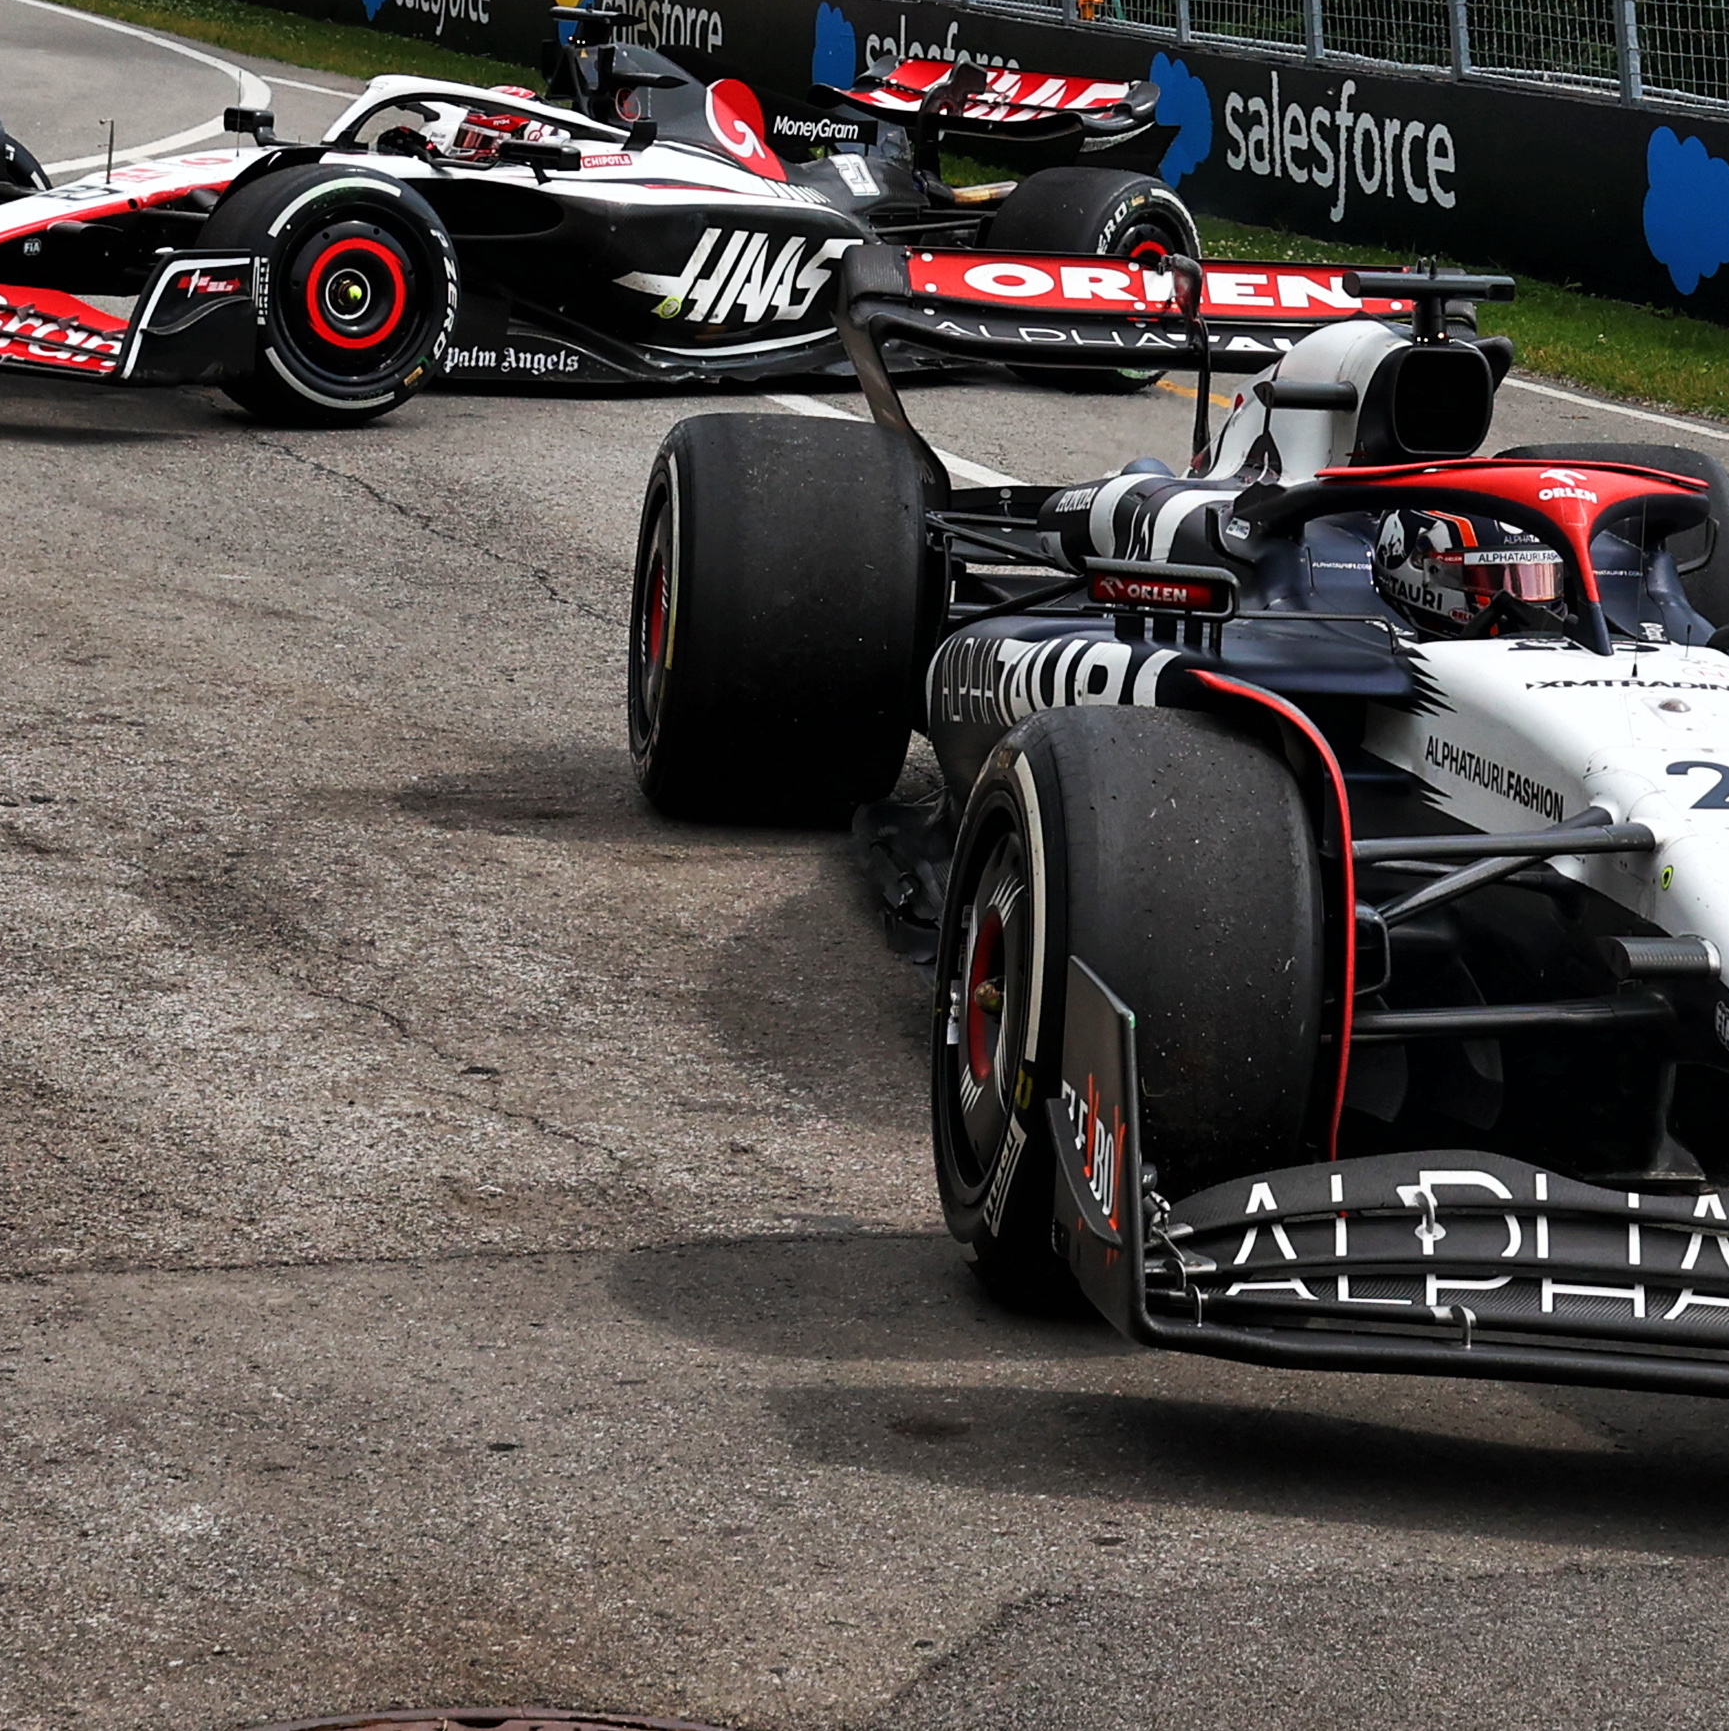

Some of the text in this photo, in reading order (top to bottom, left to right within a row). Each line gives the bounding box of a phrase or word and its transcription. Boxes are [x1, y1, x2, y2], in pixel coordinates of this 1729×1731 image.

[774, 115, 859, 141] MoneyGram
[1225, 70, 1457, 223] salesforce
[584, 154, 631, 167] CHIPOTLE
[24, 241, 40, 253] FIA
[612, 228, 864, 324] HAAS
[430, 229, 458, 360] P ZERO
[444, 346, 579, 375] Palm Angels
[1055, 486, 1099, 513] HONDA
[1539, 488, 1598, 504] ORLEN
[1127, 585, 1187, 603] ORLEN
[1425, 736, 1564, 823] ALPHATAURI.FASHION
